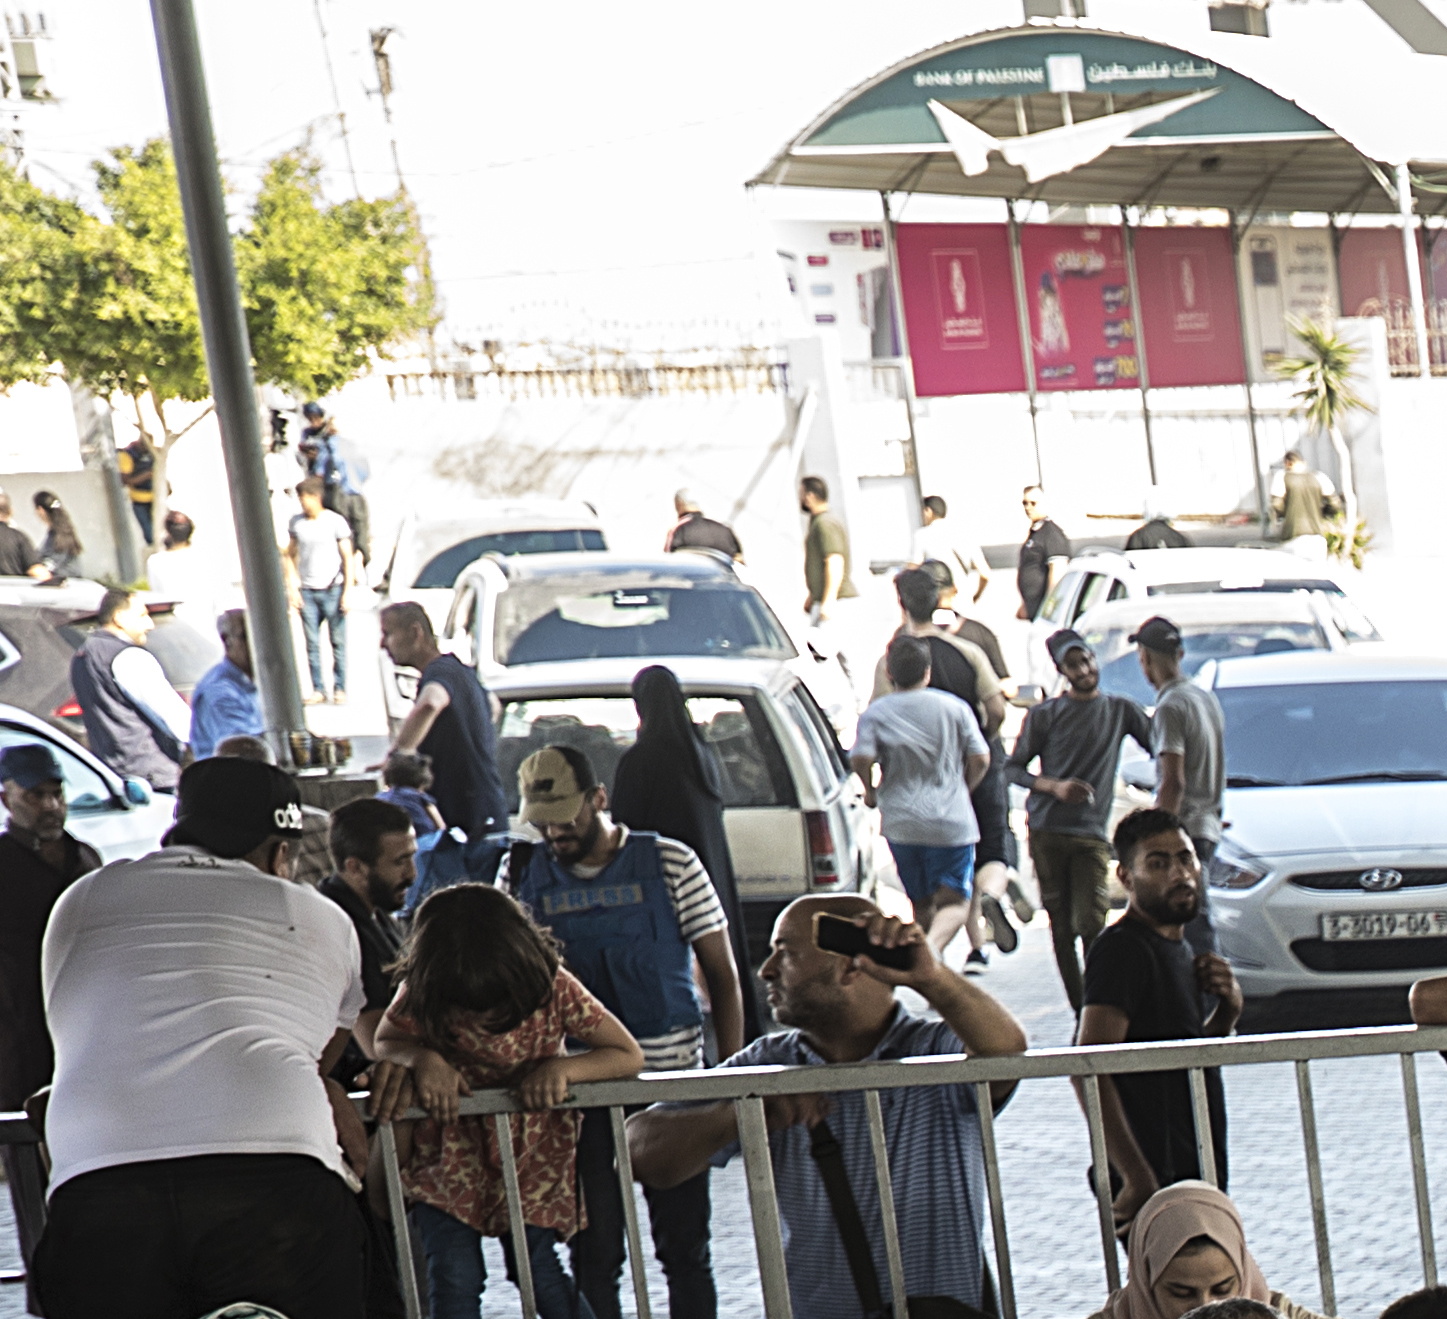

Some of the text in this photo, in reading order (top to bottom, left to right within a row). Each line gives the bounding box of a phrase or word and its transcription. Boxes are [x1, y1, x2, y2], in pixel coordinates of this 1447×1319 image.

[913, 66, 1044, 87] BANK OF PALESTINE
[549, 887, 637, 911] PRESS
